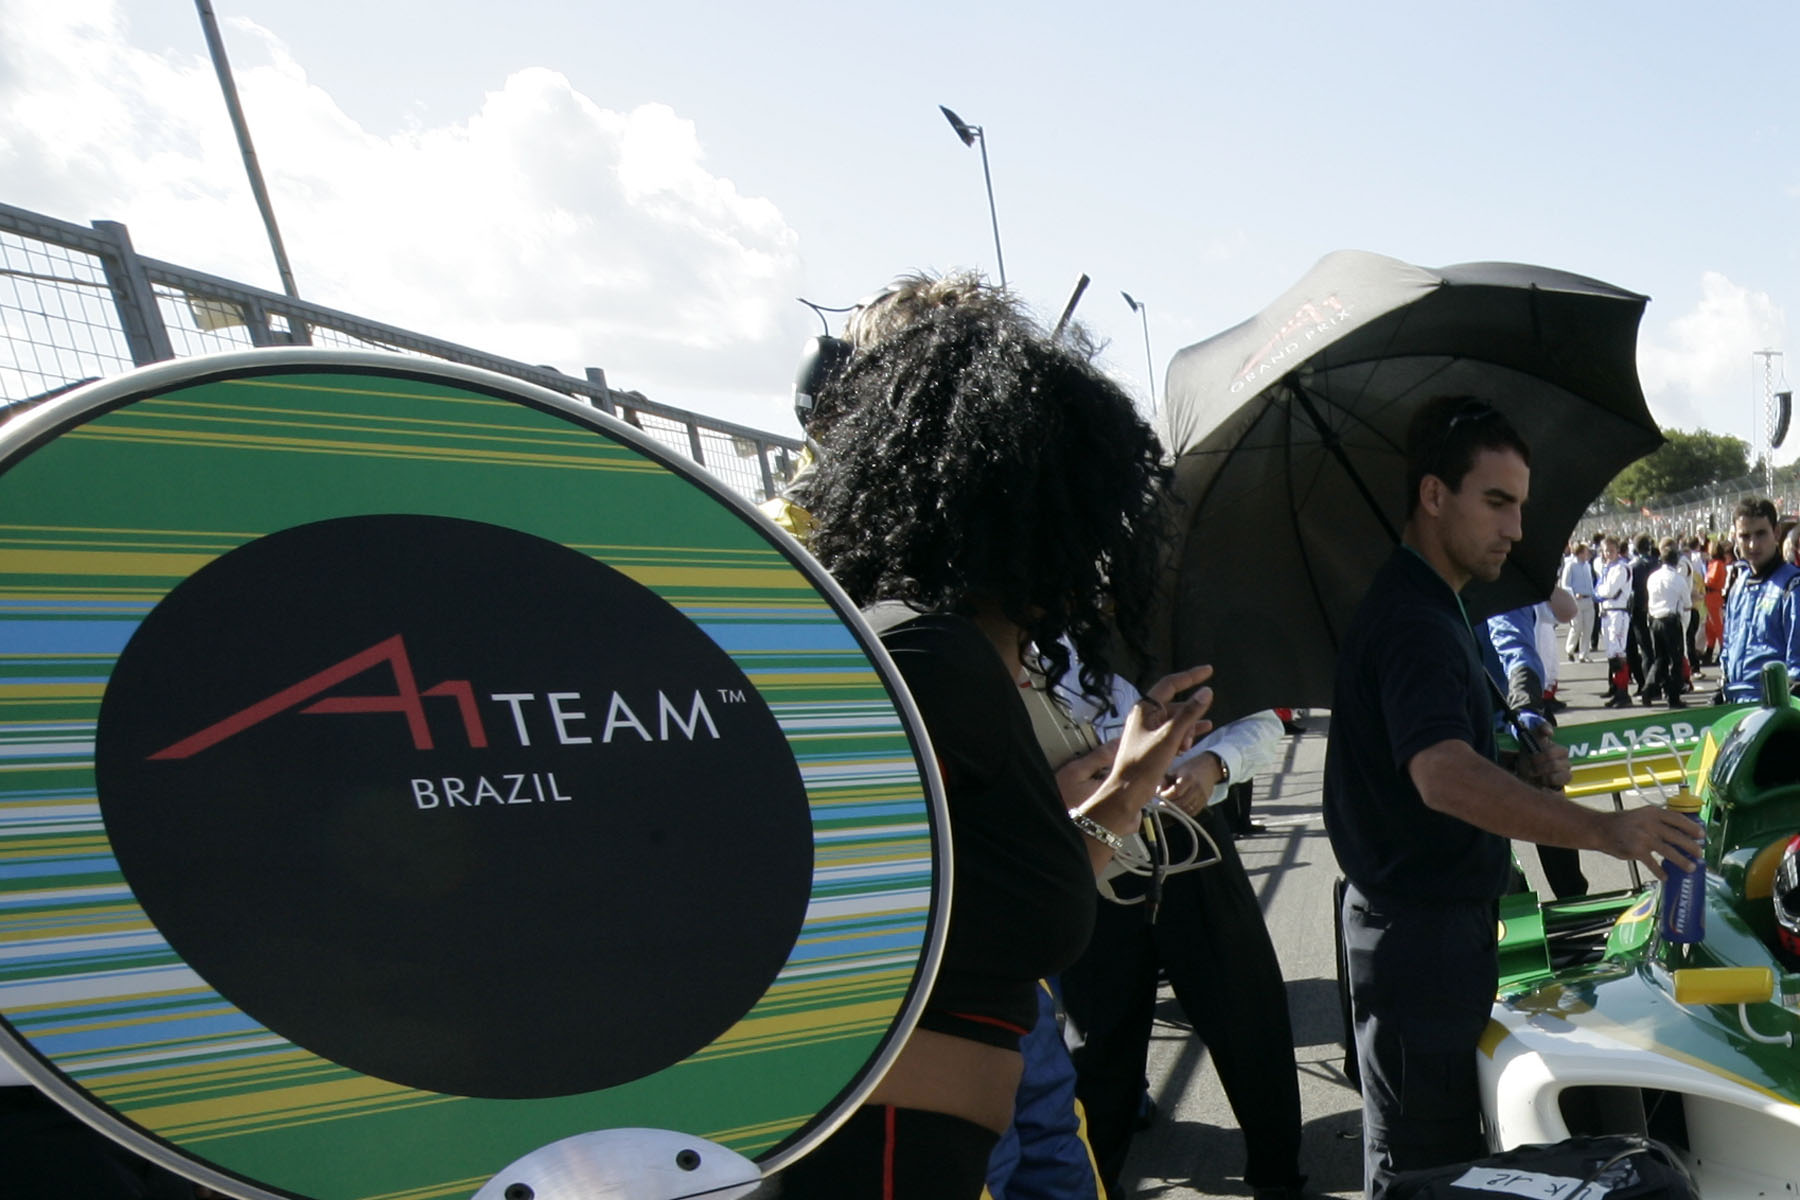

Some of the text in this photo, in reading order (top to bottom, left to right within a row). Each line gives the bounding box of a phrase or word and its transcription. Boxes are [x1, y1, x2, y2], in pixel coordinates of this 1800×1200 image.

[1230, 308, 1351, 393] GRAND PRIX
[410, 771, 572, 810] BRAZIL
